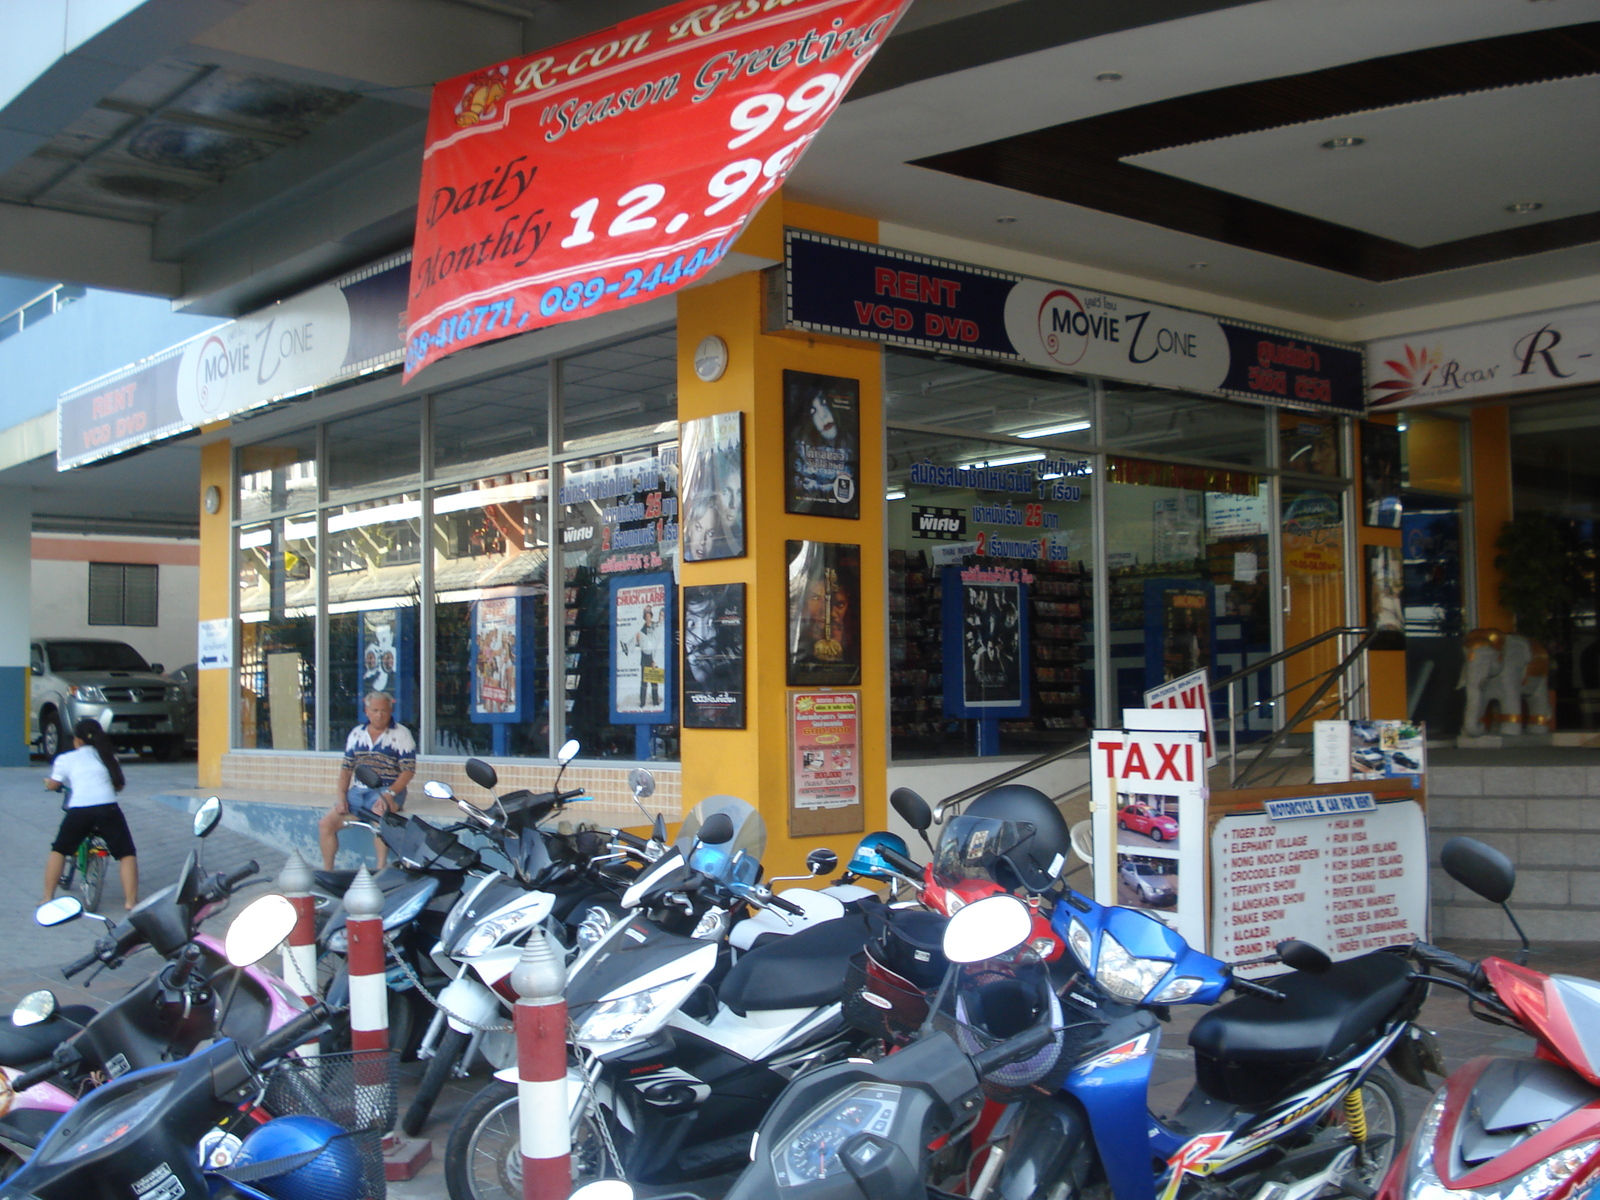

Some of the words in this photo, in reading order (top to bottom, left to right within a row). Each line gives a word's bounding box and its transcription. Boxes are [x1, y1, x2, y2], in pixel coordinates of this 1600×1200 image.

[511, 28, 652, 93] R-con
[424, 156, 540, 231] Daily
[414, 219, 552, 299] Monthly
[874, 265, 961, 309] RENT
[854, 300, 914, 331] VCD
[925, 313, 980, 343] DVD
[1052, 308, 1120, 343] MOVIE
[1124, 310, 1196, 364] ZONE
[204, 344, 250, 383] MOVIE
[255, 317, 313, 385] ZONE
[92, 382, 137, 420] RENT
[83, 424, 111, 448] VCD
[116, 411, 147, 438] DVD
[645, 492, 662, 519] 25
[919, 513, 960, 532] พิเศษ
[1025, 503, 1043, 527] 25
[563, 526, 593, 543] พิเศษ
[602, 526, 610, 551] 2
[657, 518, 663, 543] 1
[975, 531, 985, 556] 2
[1040, 537, 1047, 560] 1
[1097, 741, 1195, 782] TAXI
[1269, 800, 1316, 817] MOTORCYCLE
[1325, 798, 1341, 811] CAR
[1340, 797, 1355, 810] FOR
[1354, 795, 1372, 808] RENT
[1231, 827, 1256, 839] TIGER
[1258, 826, 1276, 837] ZOO
[1333, 833, 1349, 843] RUN
[1231, 839, 1273, 853] ELEPHANT
[1276, 835, 1308, 849] VILLAGE
[1332, 847, 1348, 857] KOH
[1372, 841, 1398, 853] ISLAND
[1231, 856, 1254, 868] NONG
[1257, 853, 1285, 865] NOOCH
[1332, 860, 1348, 870] KOH
[1351, 857, 1375, 869] SAMET
[1378, 854, 1404, 866] ISLAND
[1231, 867, 1276, 882] CROCODILE
[1279, 864, 1301, 876] FARM
[1332, 873, 1348, 884] KOH
[1351, 870, 1376, 882] CHANG
[1378, 867, 1404, 879] ISLAND
[1231, 882, 1271, 897] TIFFANY'S
[1273, 879, 1296, 892] SHOW
[1332, 886, 1354, 897] RIVER
[1282, 892, 1306, 905] SHOW
[1366, 894, 1396, 907] MARKET
[1232, 912, 1259, 926] SNAKE
[1261, 909, 1285, 922] SHOW
[1333, 913, 1355, 925] OASIS
[1357, 911, 1371, 922] SEA
[1373, 907, 1399, 919] WORLD
[1233, 926, 1271, 941] ALCAZAR
[1335, 926, 1364, 938] YELLOW
[1366, 919, 1408, 934] SUBMARINE
[1234, 942, 1263, 956] GRAND
[1336, 940, 1360, 953] UNDER
[1362, 936, 1387, 948] WATER
[629, 1063, 665, 1075] HONDA
